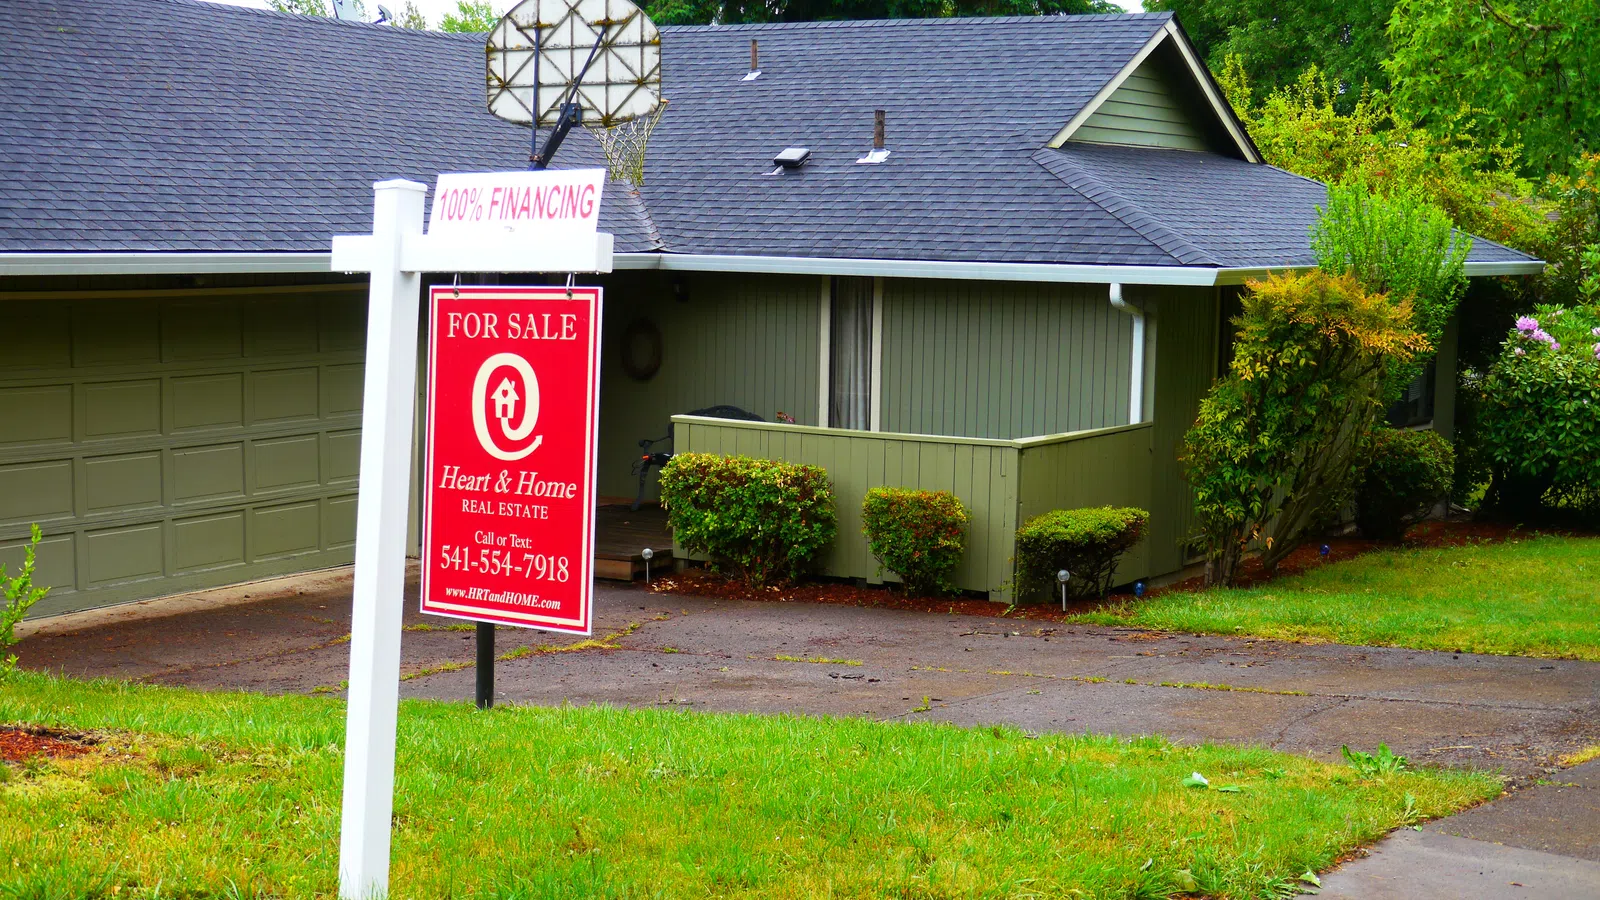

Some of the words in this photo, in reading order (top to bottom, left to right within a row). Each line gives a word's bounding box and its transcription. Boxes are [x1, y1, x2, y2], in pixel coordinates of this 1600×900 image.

[440, 187, 484, 221] 100%
[488, 183, 595, 221] FINANCING
[447, 312, 499, 339] FOR
[507, 313, 577, 340] SALE
[439, 465, 491, 493] Heart
[494, 469, 512, 494] &
[514, 470, 577, 499] Home
[462, 499, 494, 515] REAL
[498, 502, 549, 520] ESTATE
[474, 530, 494, 545] Call
[496, 535, 507, 546] or
[509, 533, 532, 549] Text:
[440, 544, 569, 583] 541-554-7918
[445, 587, 561, 610] www.HRTandHOME.com
